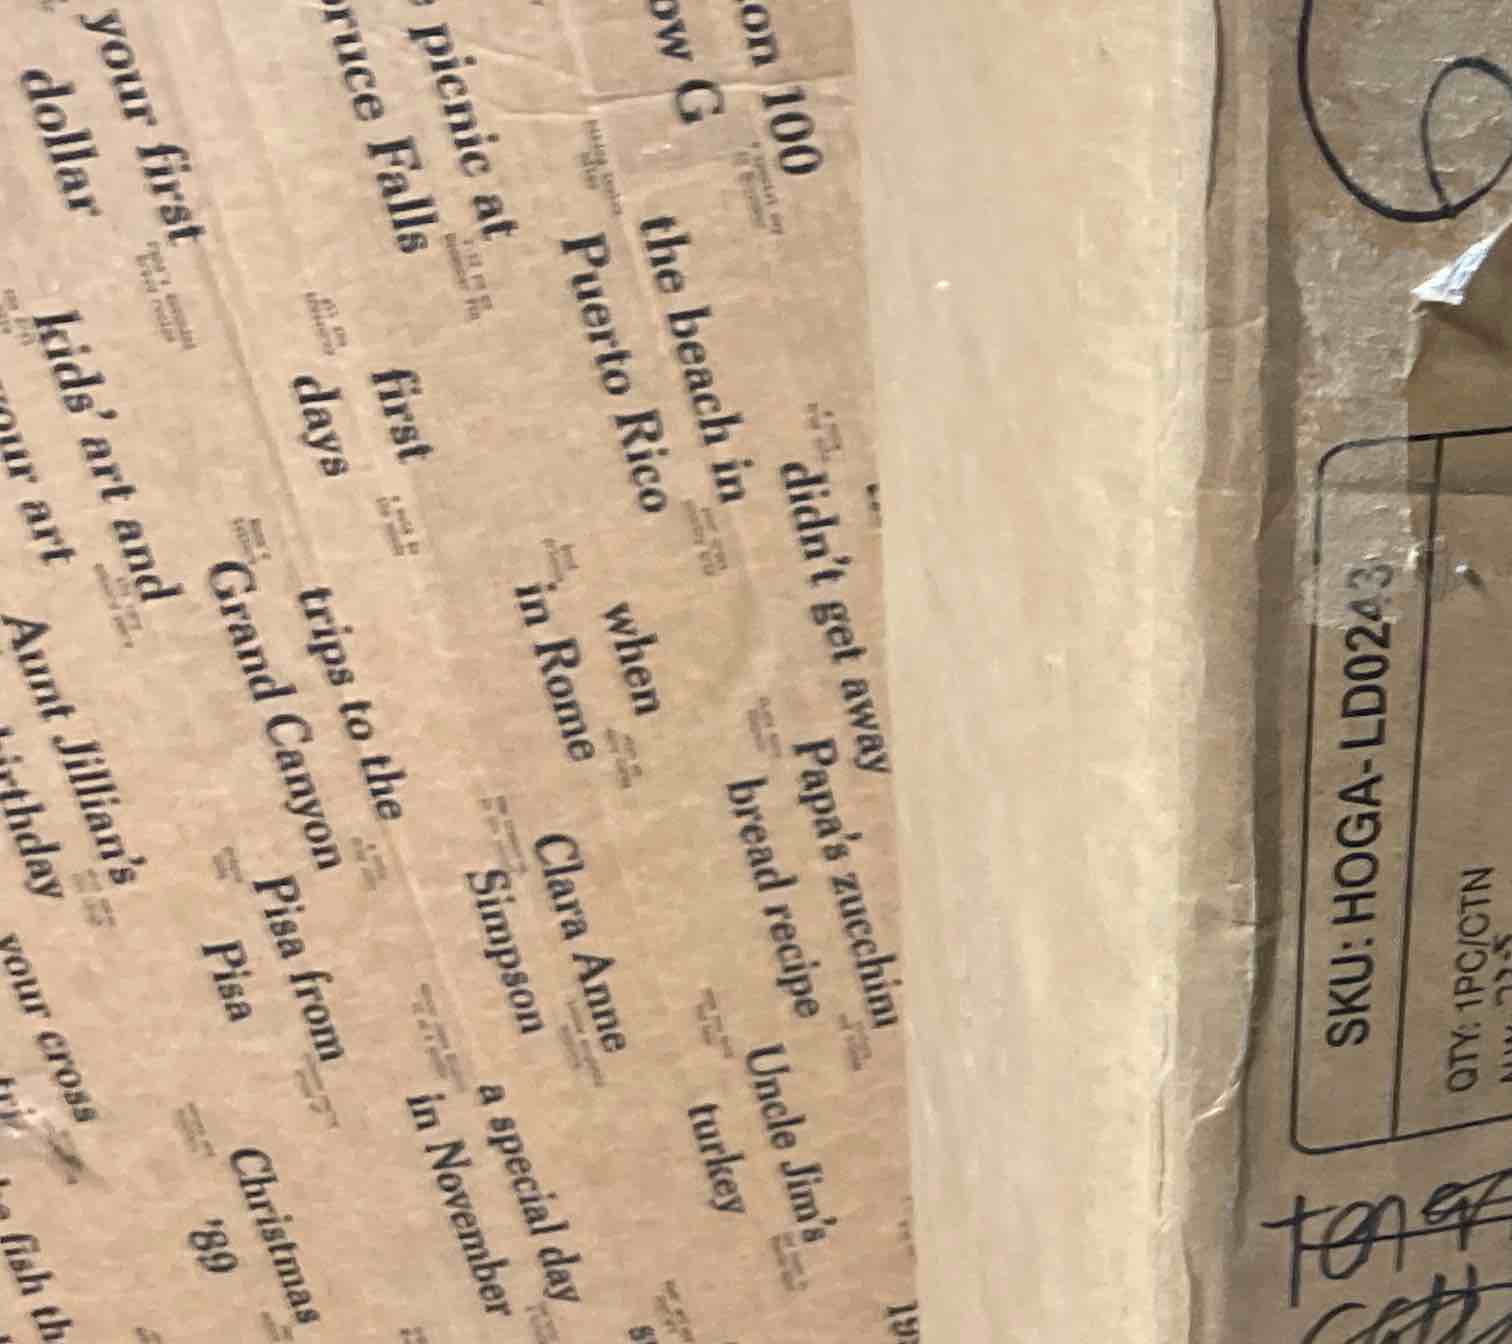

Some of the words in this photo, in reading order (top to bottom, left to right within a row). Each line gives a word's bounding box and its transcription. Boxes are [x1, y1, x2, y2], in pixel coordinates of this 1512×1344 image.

[19, 67, 102, 219] dollar
[79, 9, 157, 128] your
[136, 142, 206, 244] first
[408, 22, 500, 179] picnic
[472, 191, 521, 241] at
[674, 76, 726, 126] G
[761, 85, 826, 177] 100
[364, 134, 441, 255] Falls
[369, 367, 435, 464] first
[559, 231, 634, 398] Puerto
[614, 407, 672, 515] Rico
[639, 214, 693, 296] the
[666, 304, 746, 448] beach
[710, 457, 755, 505] in
[0, 380, 39, 487] our
[31, 309, 118, 421] kids'
[79, 435, 137, 505] art
[111, 517, 185, 604] and
[289, 373, 352, 479] days
[17, 498, 78, 568] art
[778, 460, 855, 589] didn't
[513, 582, 558, 629] in
[600, 600, 661, 719] when
[808, 599, 870, 666] get
[0, 613, 77, 724] Aunt
[50, 734, 149, 887] Jillian's
[206, 558, 299, 705] Grand
[263, 711, 344, 874] Canyon
[299, 585, 356, 690] trips
[337, 698, 376, 743] to
[358, 754, 408, 825] the
[532, 637, 596, 764] Rome
[840, 676, 893, 776] away
[1332, 558, 1396, 929] HOGA-LD0243
[532, 831, 590, 943] Clara
[571, 950, 629, 1055] Anne
[724, 774, 800, 895] bread
[762, 901, 822, 1020] recipe
[791, 736, 864, 863] Papa's
[829, 869, 904, 1030] zucchini
[1453, 864, 1496, 1012] 1PC/CTN
[200, 937, 255, 1025] Pisa
[251, 873, 308, 961] Pisa
[288, 967, 347, 1064] from
[464, 867, 545, 1036] Simpson
[1325, 938, 1376, 1051] SKU:
[35, 1026, 100, 1125] cross
[403, 1091, 447, 1132] in
[477, 1082, 508, 1107] a
[1445, 1019, 1482, 1093] QTY:
[485, 1115, 570, 1238] special
[686, 1101, 747, 1219] turkey
[743, 1041, 808, 1152] Uncle
[779, 1160, 840, 1245] Jim's
[227, 1145, 323, 1327] Christmas
[423, 1137, 515, 1319] November
[535, 1243, 584, 1306] day
